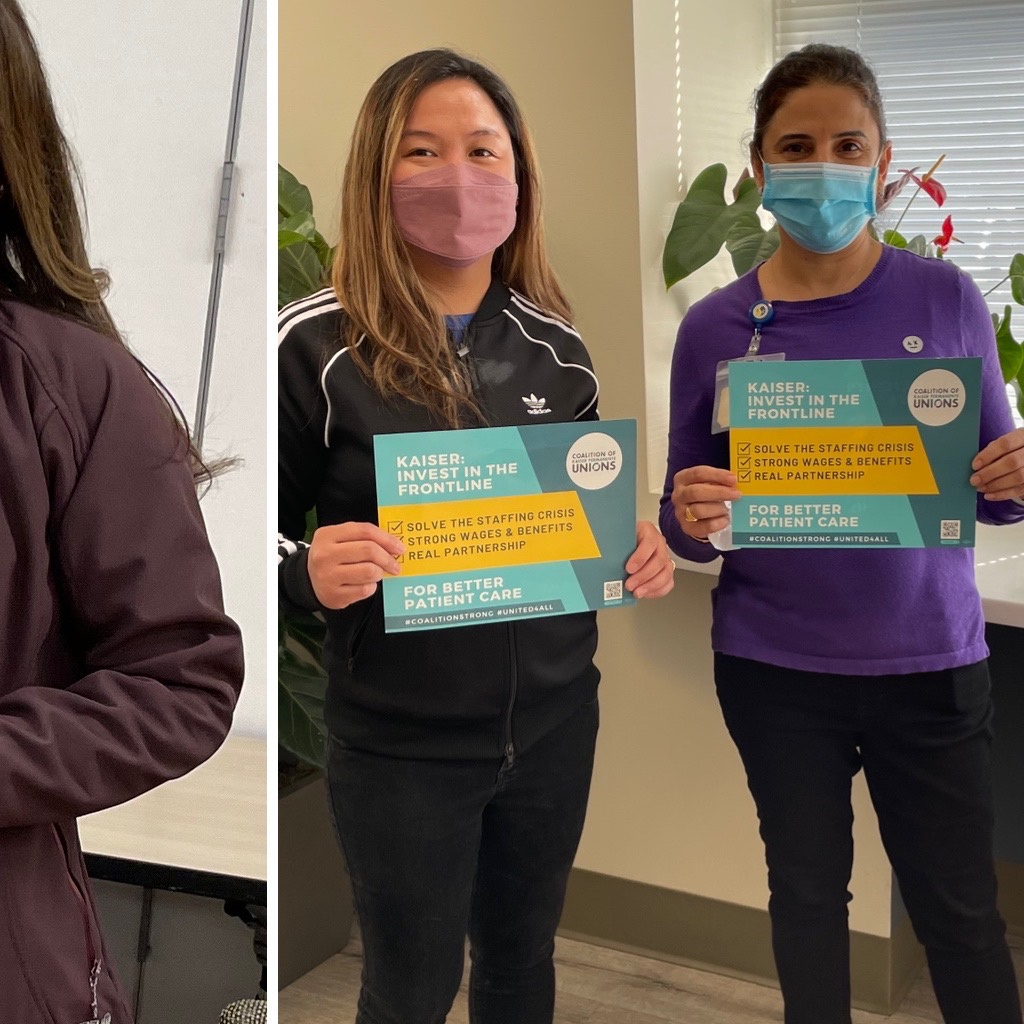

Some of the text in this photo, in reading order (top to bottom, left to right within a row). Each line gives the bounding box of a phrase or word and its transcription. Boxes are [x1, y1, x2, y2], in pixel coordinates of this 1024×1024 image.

[747, 382, 809, 393] KAISER:
[748, 394, 859, 405] INVEST IN THE
[913, 398, 958, 408] UNIONS
[748, 408, 834, 419] FRONTLINE
[754, 443, 913, 453] SOLVE THE STAFFING CRISIS
[572, 461, 616, 473] UNIONS
[407, 522, 572, 546] STRONG WAGES & BENEFITS
[408, 540, 525, 560] REAL PARTNERSHIP
[404, 576, 503, 597] FOR BETTER
[405, 602, 552, 626] #COALITIONSTRONG #UNITED4ALL
